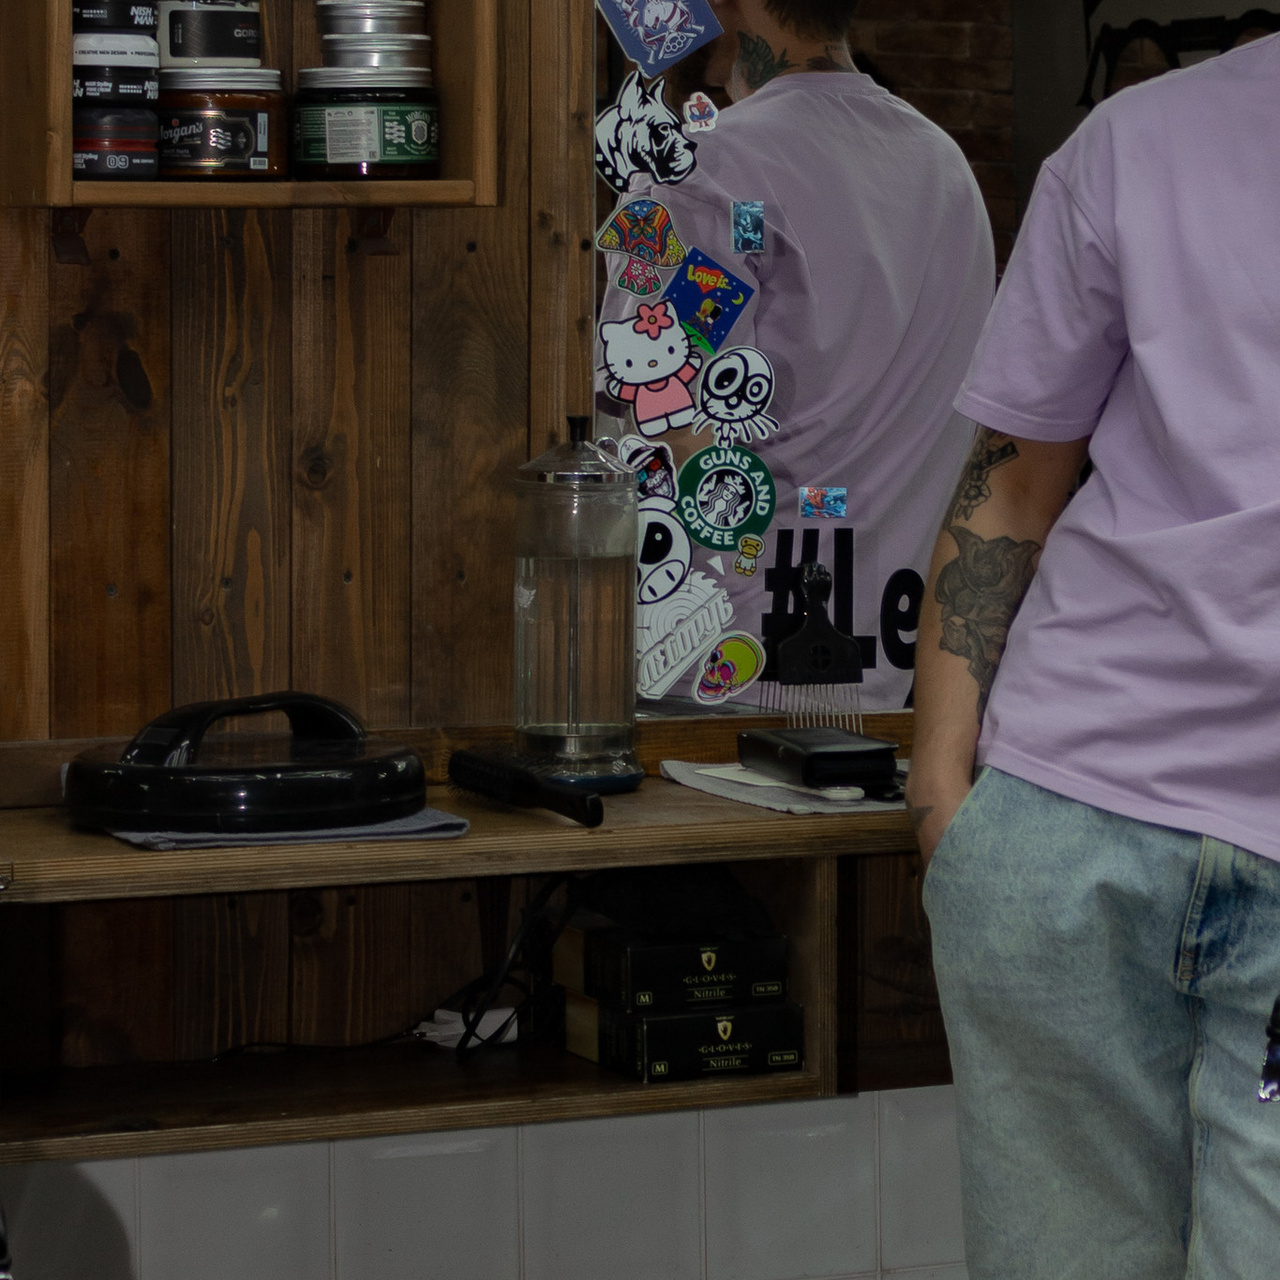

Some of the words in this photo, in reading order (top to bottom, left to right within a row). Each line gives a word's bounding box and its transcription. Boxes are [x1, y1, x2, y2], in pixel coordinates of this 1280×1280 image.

[130, 5, 153, 16] NISH
[134, 15, 154, 26] MAN
[106, 154, 129, 169] 09
[687, 264, 717, 286] Love
[699, 449, 752, 470] GUNS
[750, 470, 771, 516] AND
[681, 495, 735, 546] COFFEE
[639, 994, 650, 1004] M
[693, 988, 726, 999] Nitrile
[654, 1063, 666, 1073] M
[709, 1057, 742, 1068] Nitrile
